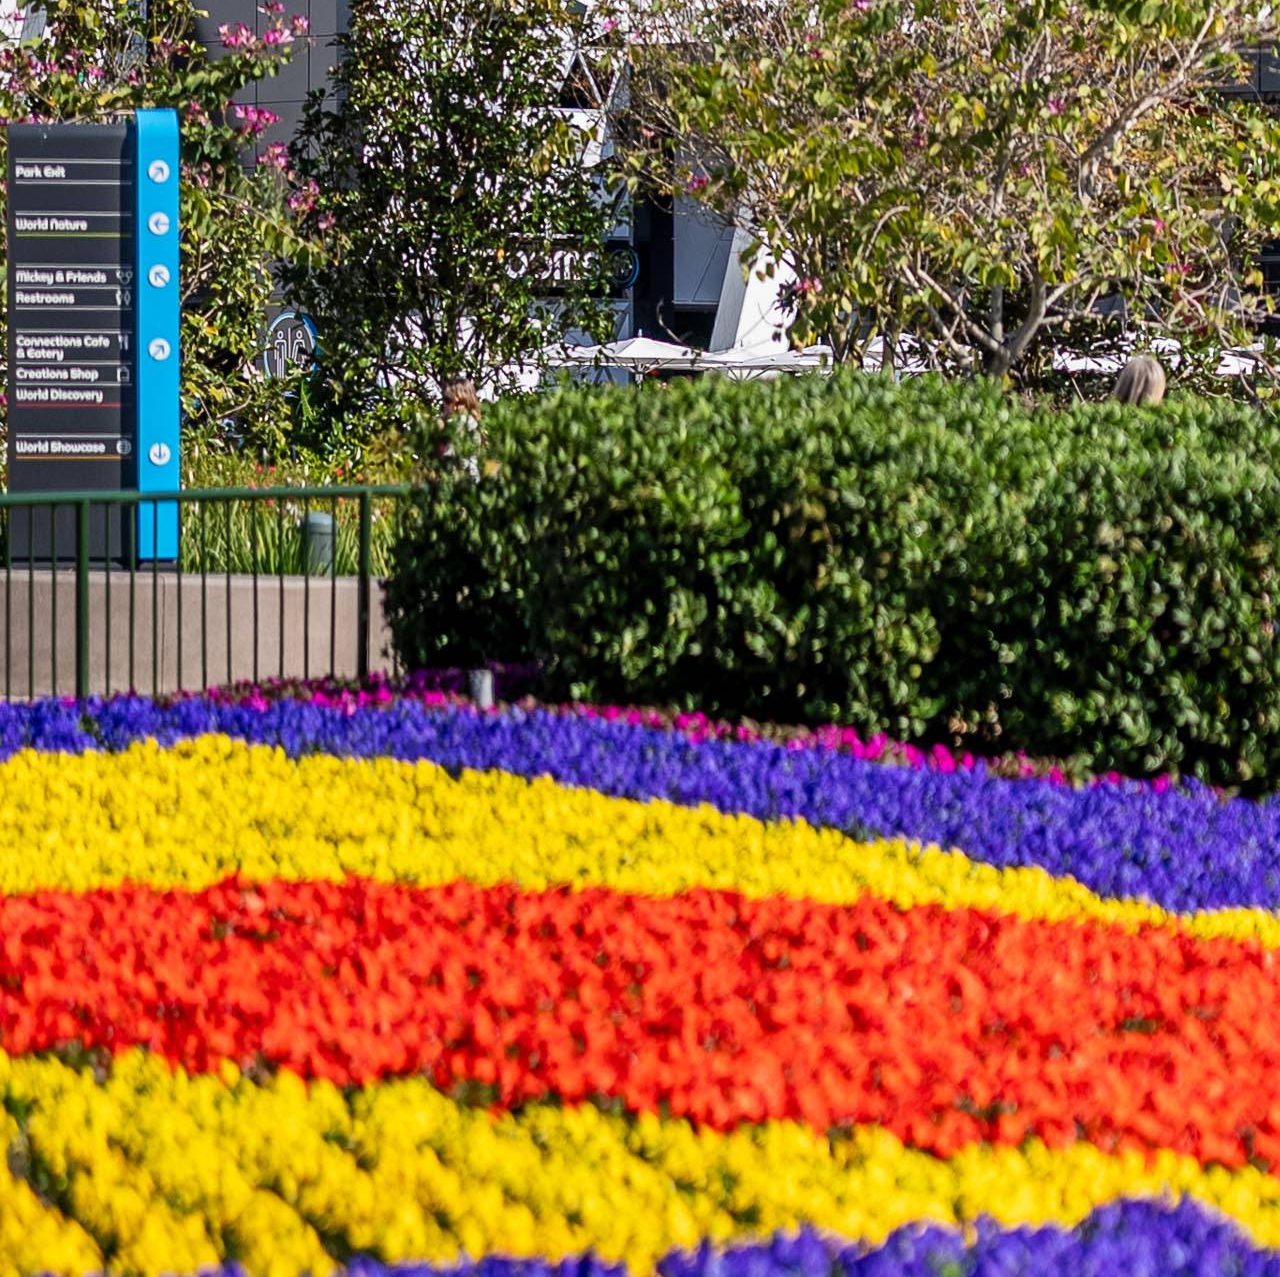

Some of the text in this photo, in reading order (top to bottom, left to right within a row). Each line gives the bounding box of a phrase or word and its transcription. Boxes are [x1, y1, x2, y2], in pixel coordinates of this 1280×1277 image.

[16, 165, 66, 178] Park Exit
[16, 218, 88, 231] World Nature
[16, 270, 107, 285] Mickey & Friends
[16, 291, 75, 304] Restrooms
[16, 335, 110, 347] Connections Cafe
[16, 348, 64, 361] & Eatery
[16, 367, 99, 382] Creations Shop
[16, 388, 103, 403] World Discovery
[16, 441, 106, 454] World Showcase
